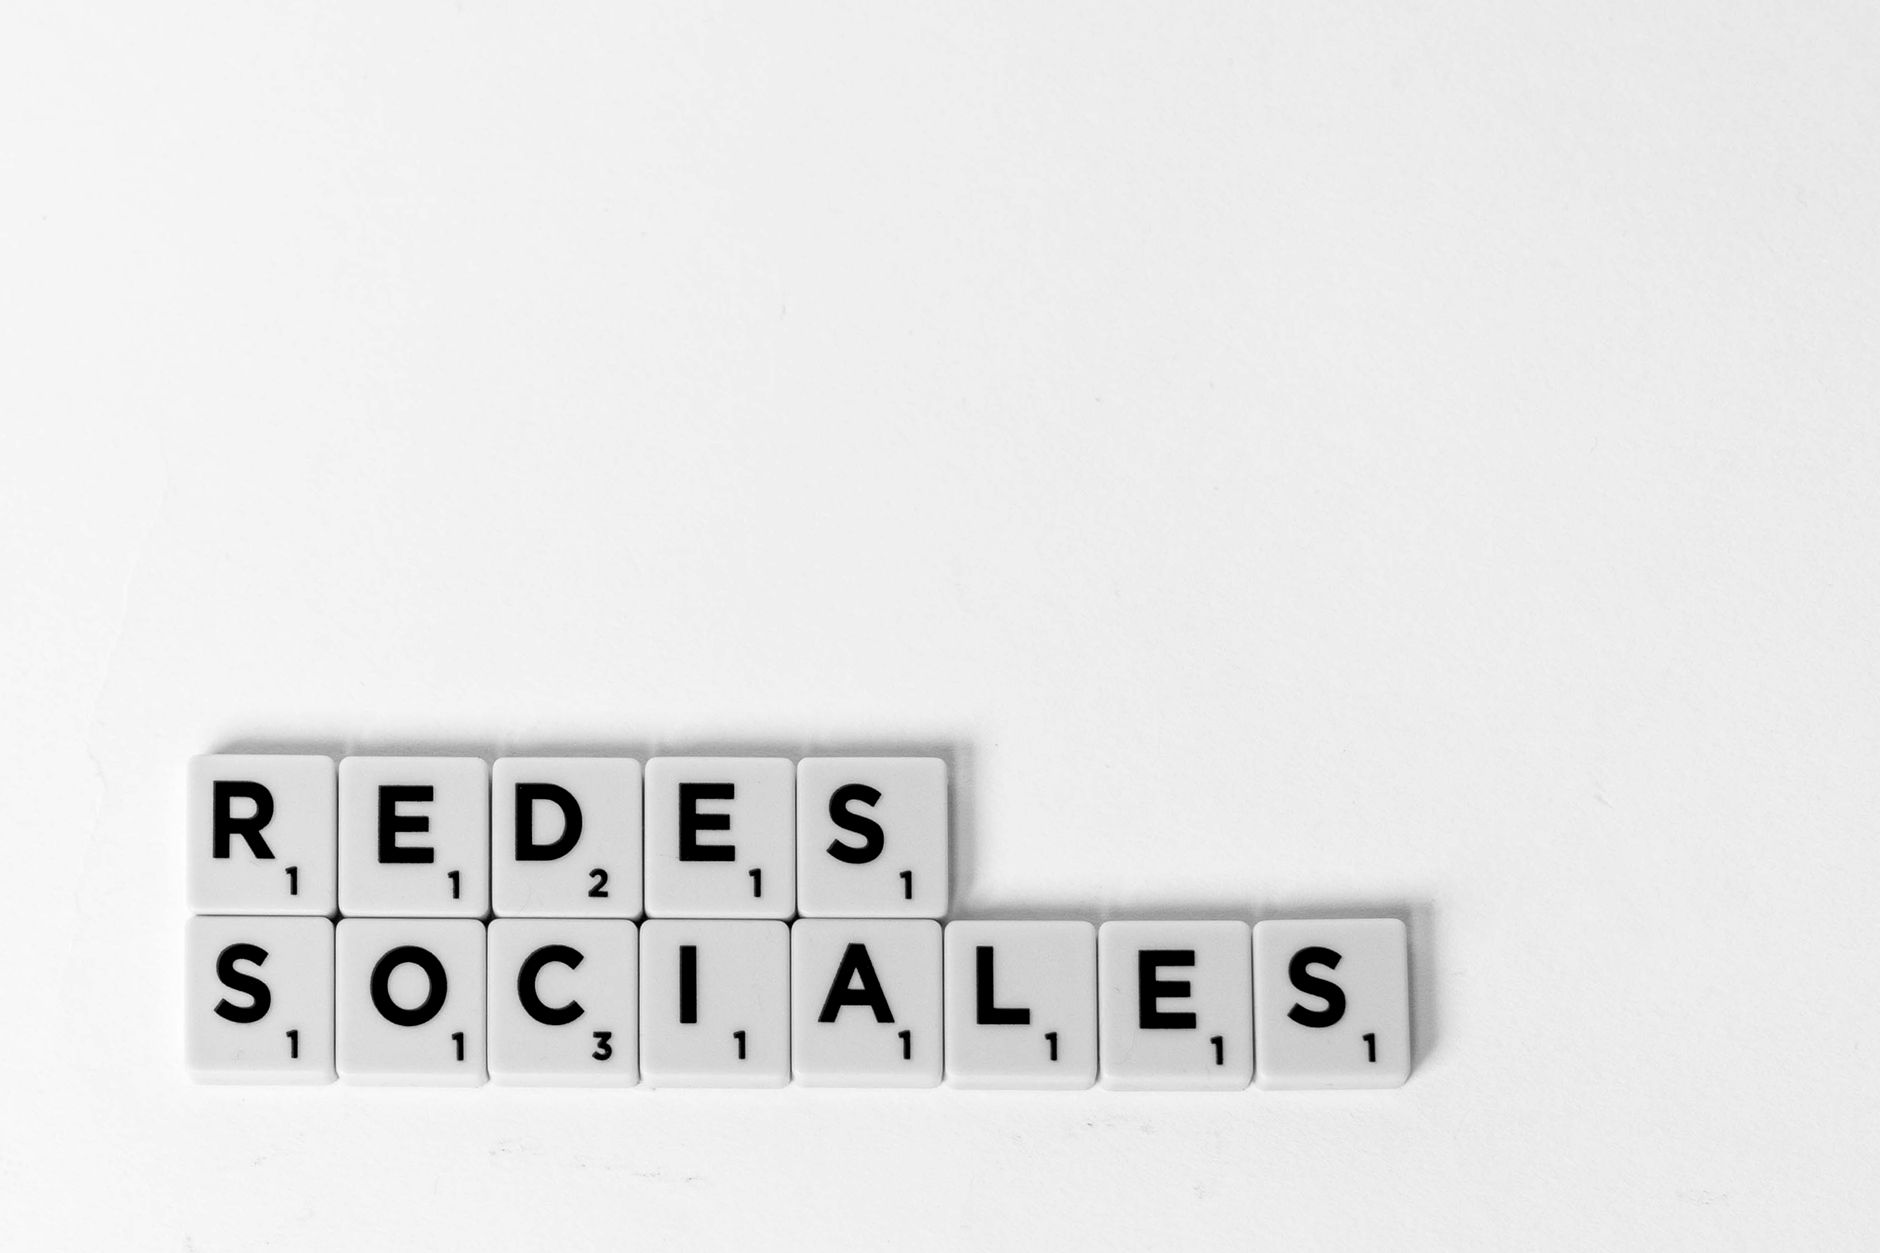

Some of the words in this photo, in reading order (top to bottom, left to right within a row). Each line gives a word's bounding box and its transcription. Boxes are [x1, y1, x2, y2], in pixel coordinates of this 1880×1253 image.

[213, 780, 886, 865] REDES
[285, 866, 298, 896] 1
[447, 870, 460, 900] 1
[588, 868, 609, 898] 2
[748, 868, 762, 898] 1
[899, 870, 913, 900] 1
[213, 943, 1348, 1030] SOCIALES
[286, 1029, 299, 1059] 1
[451, 1031, 464, 1061] 1
[592, 1031, 613, 1061] 3
[733, 1030, 746, 1060] 1
[898, 1030, 911, 1060] 1
[1044, 1031, 1058, 1062] 1
[1210, 1035, 1224, 1066] 1
[1362, 1032, 1376, 1063] 1
